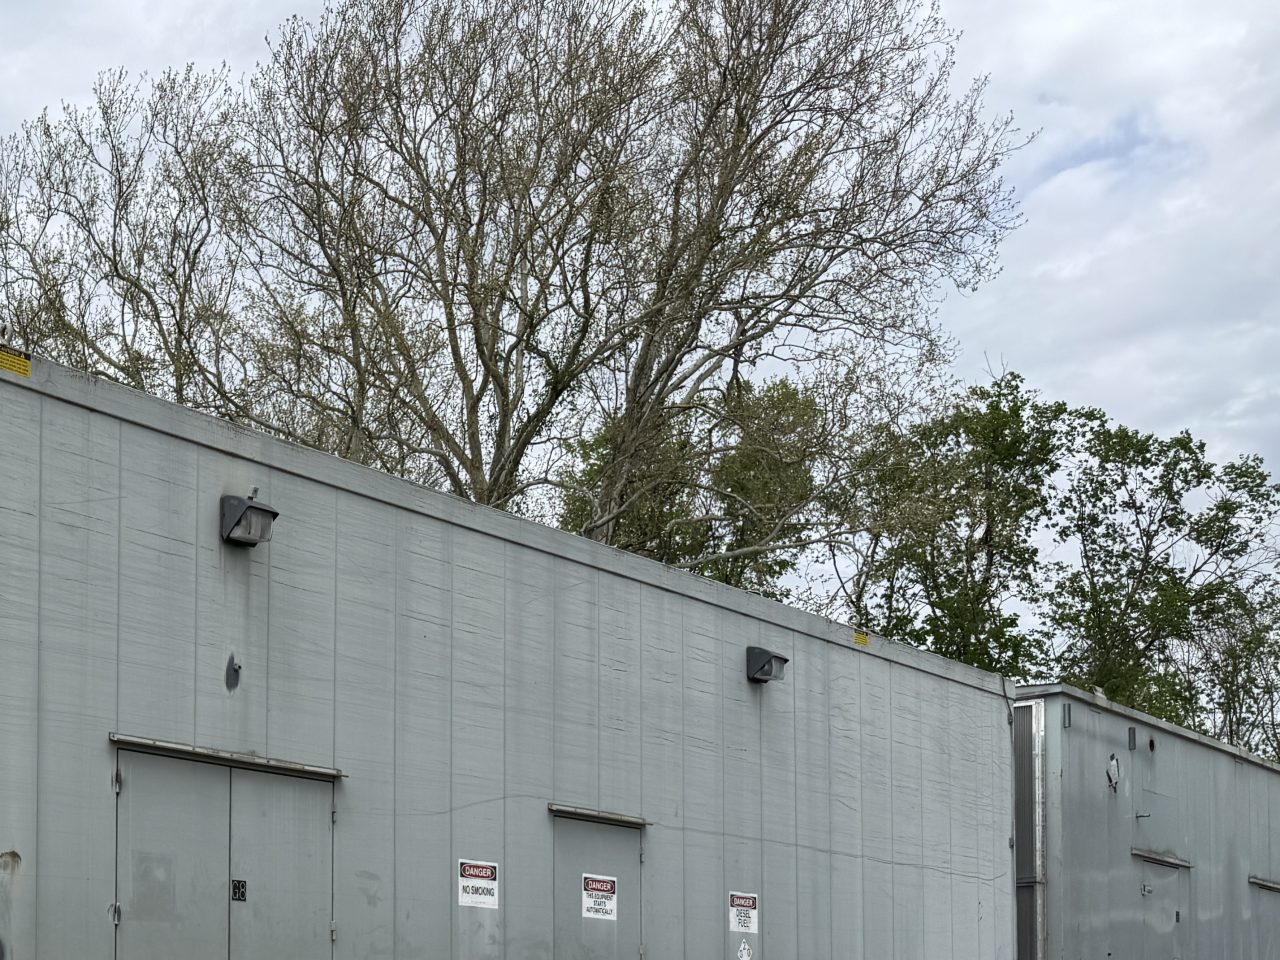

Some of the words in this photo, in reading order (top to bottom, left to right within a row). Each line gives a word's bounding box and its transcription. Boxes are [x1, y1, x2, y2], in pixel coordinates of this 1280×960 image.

[465, 866, 492, 878] DANGER
[232, 880, 246, 900] G8
[462, 885, 470, 895] NO
[471, 886, 495, 897] SMOKING
[588, 880, 612, 891] DANGER
[593, 900, 607, 908] STARTS
[733, 897, 754, 907] DANGER
[736, 908, 752, 919] DIESEL
[738, 918, 750, 928] FUEL
